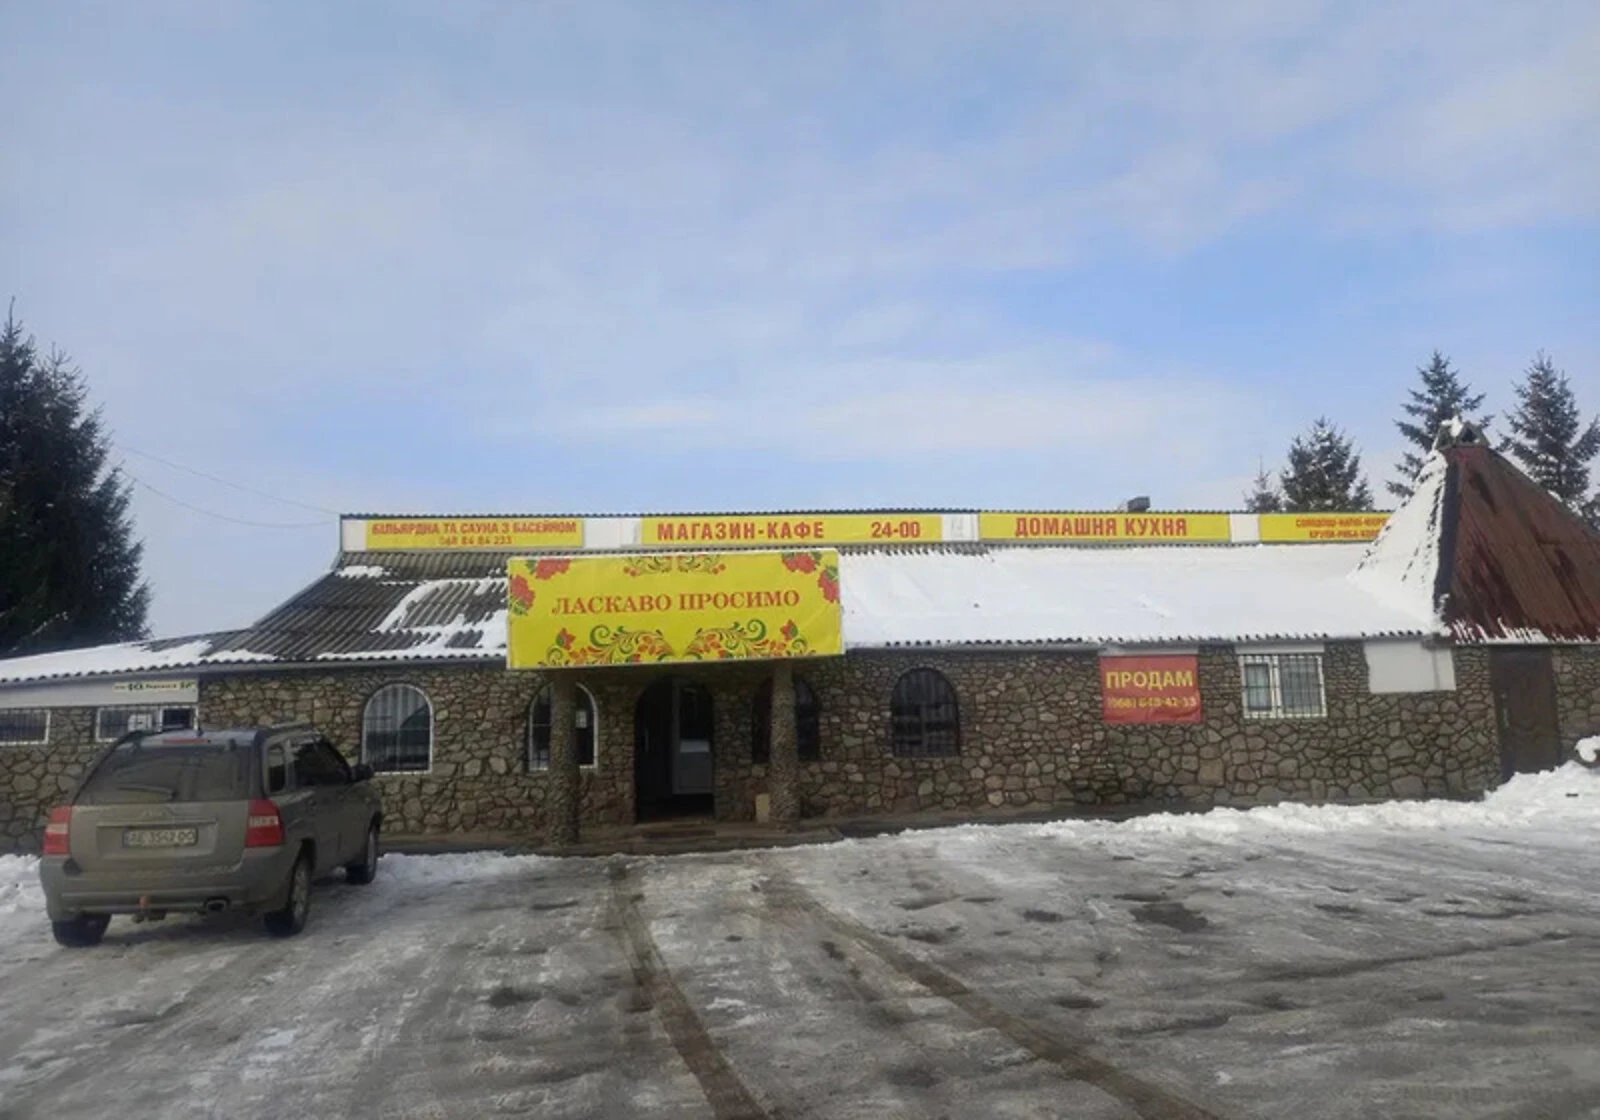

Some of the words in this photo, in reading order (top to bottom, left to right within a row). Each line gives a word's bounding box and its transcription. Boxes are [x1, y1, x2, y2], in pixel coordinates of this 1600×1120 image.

[443, 523, 458, 534] ТА
[460, 523, 499, 534] САУНА
[501, 523, 511, 533] З
[513, 520, 577, 533] БАСЕЙНОМ
[657, 522, 825, 541] МАГАЗИН-КАФЕ
[870, 521, 921, 539] 24-00
[1015, 517, 1118, 537] ДОМАШНЯ
[1124, 517, 1188, 536] КУХНЯ
[551, 595, 672, 615] ЛАСКАВО
[678, 590, 801, 610] ПРОСИМО
[1105, 670, 1194, 691] ПРОДАМ
